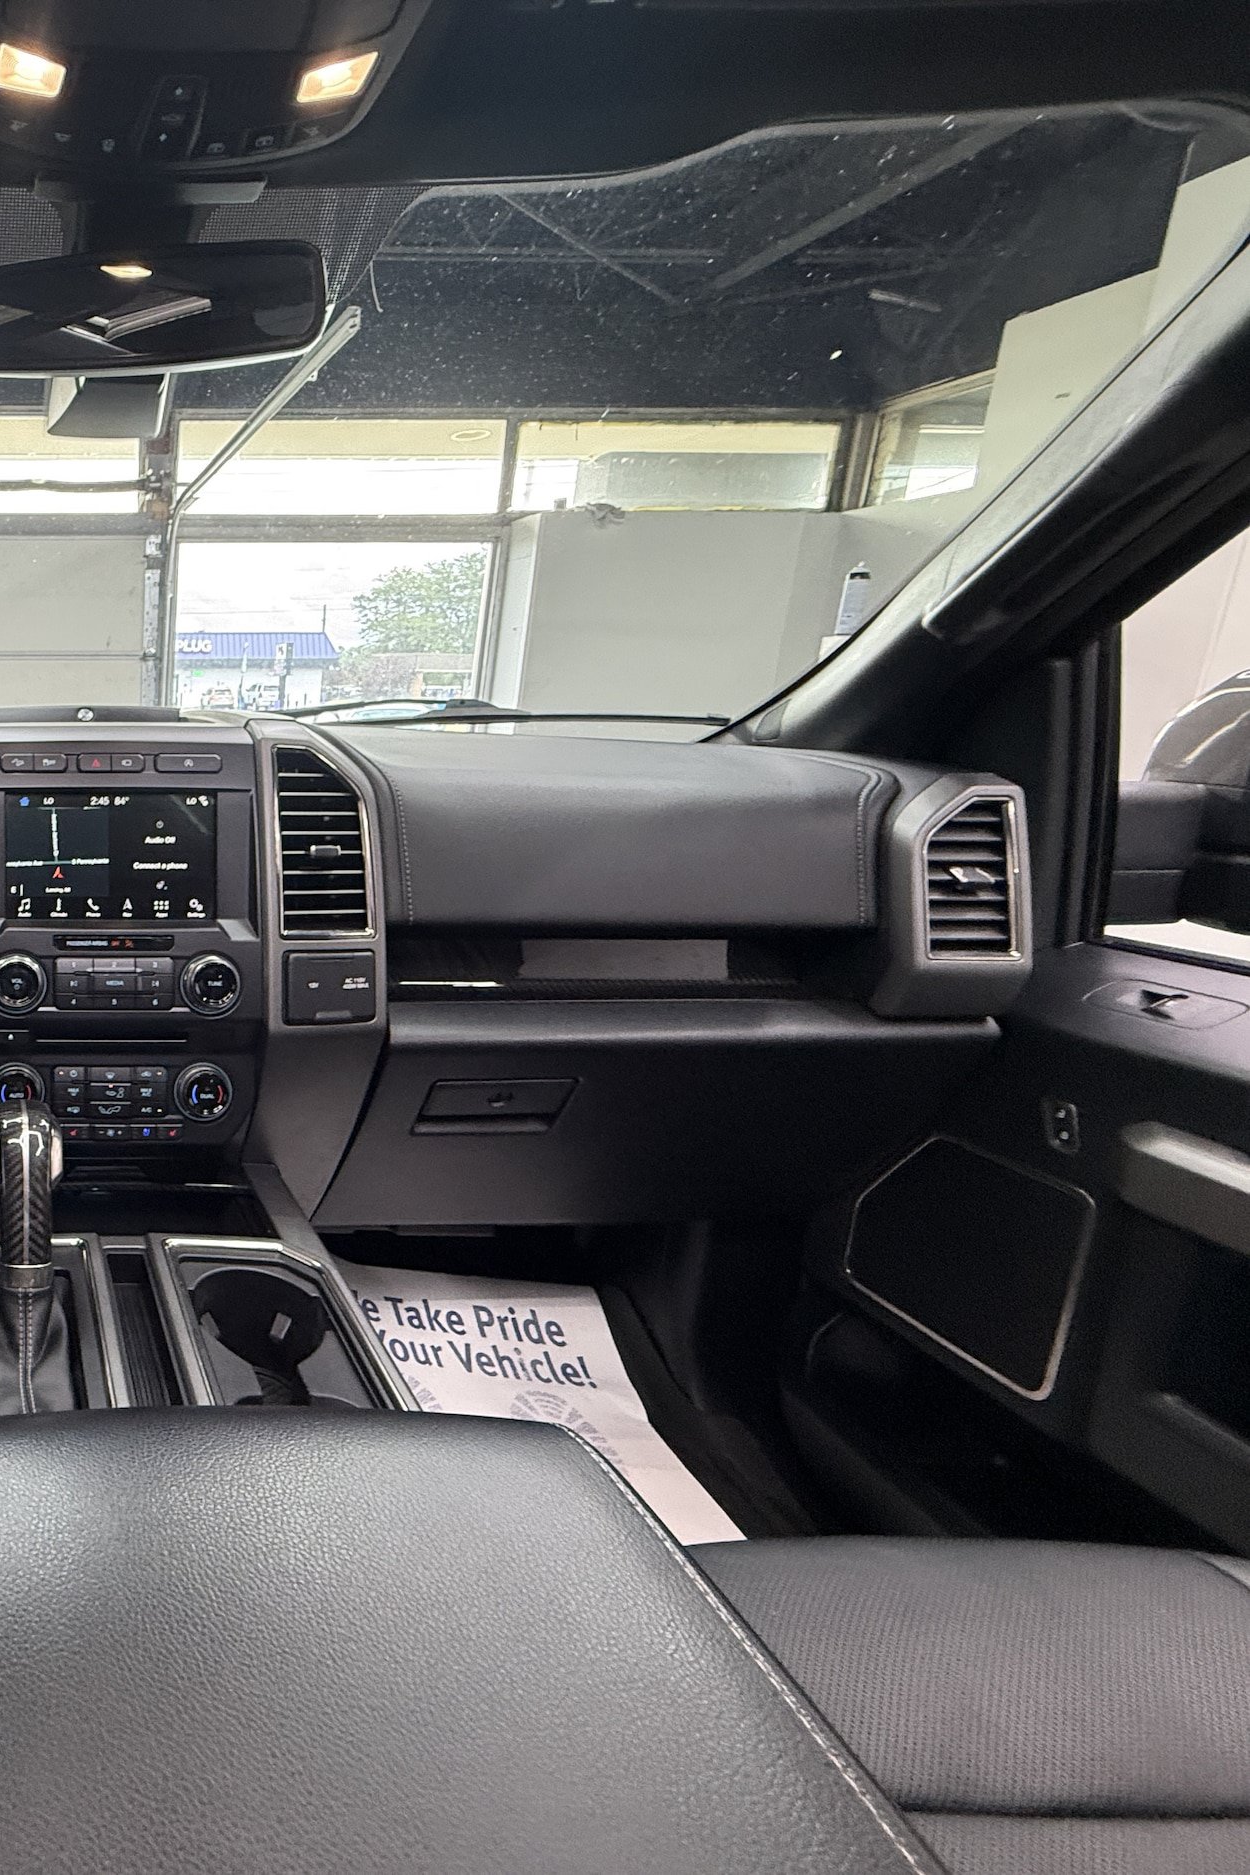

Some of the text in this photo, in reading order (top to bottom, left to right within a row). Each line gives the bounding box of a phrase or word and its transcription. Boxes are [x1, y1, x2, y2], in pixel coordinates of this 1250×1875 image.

[90, 796, 110, 805] 2:45
[144, 836, 164, 844] Audio
[133, 862, 161, 870] Connect
[167, 862, 188, 871] phone
[383, 1296, 466, 1336] Take
[473, 1305, 565, 1347] Pride
[448, 1340, 597, 1388] Vehicle!
